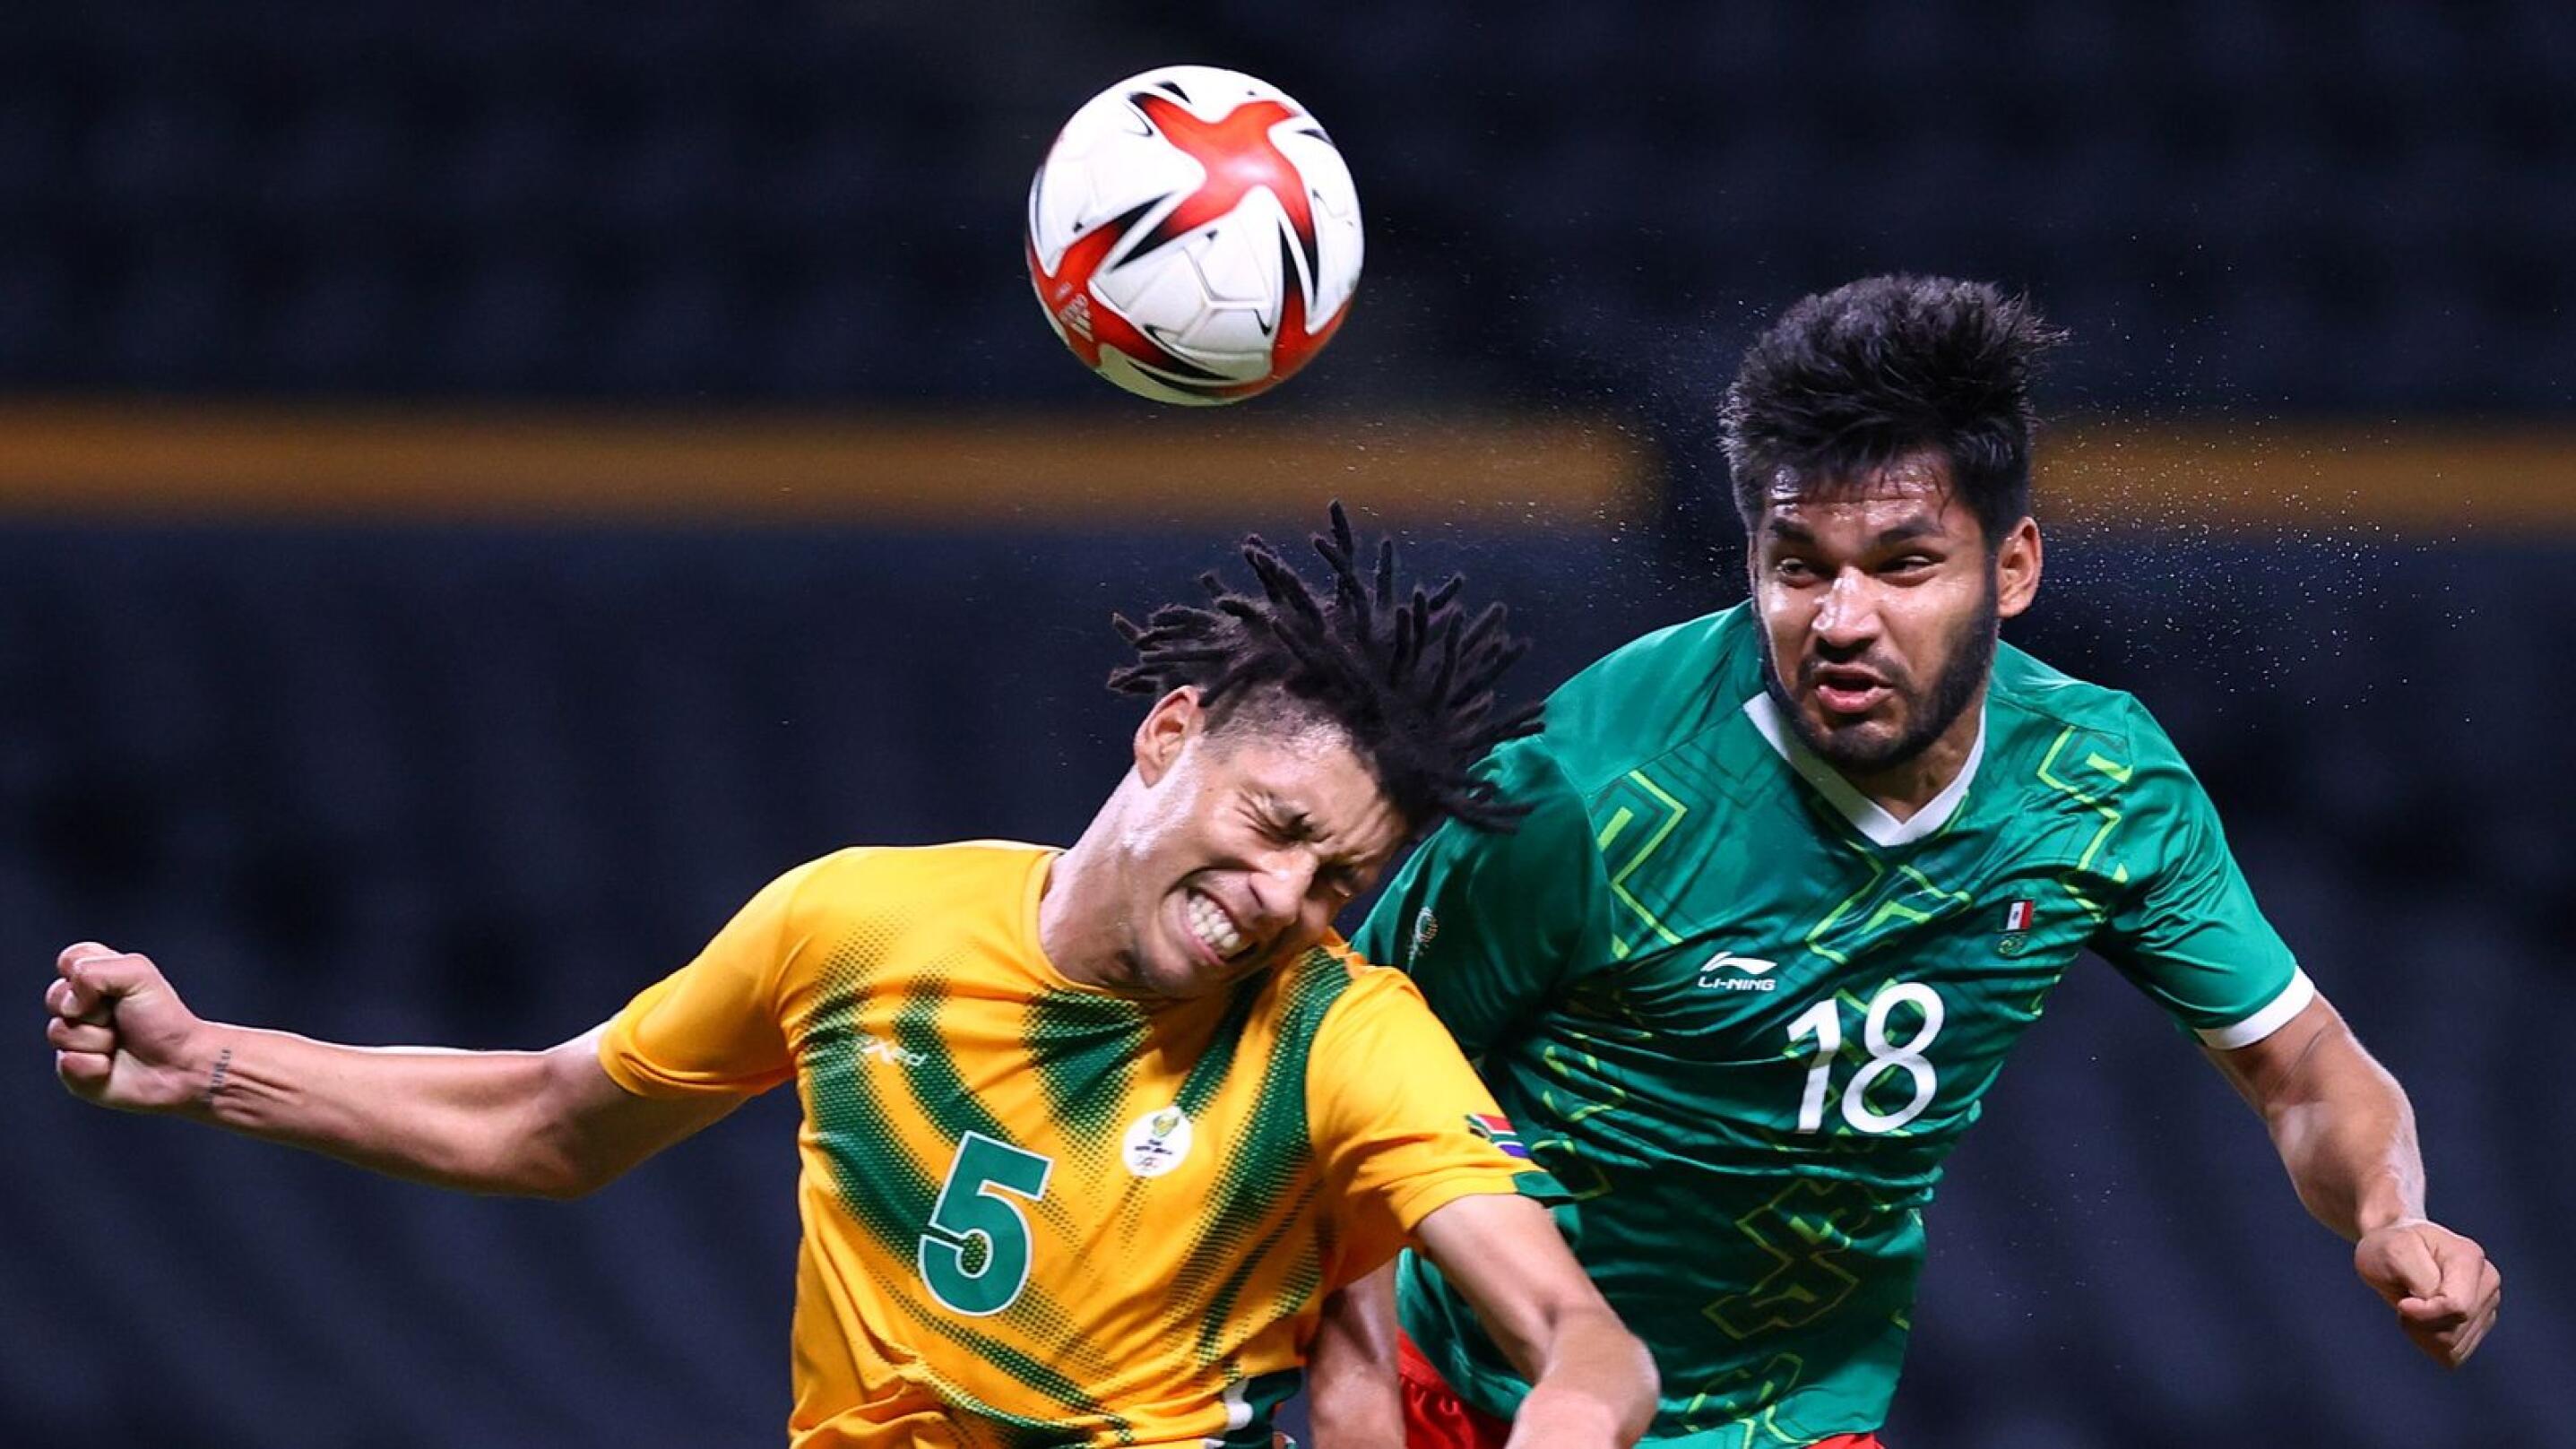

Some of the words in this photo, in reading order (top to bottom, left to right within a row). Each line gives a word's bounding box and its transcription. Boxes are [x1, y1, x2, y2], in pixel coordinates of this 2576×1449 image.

[1698, 976, 1776, 991] LI-NING
[1786, 982, 1944, 1133] 18
[918, 1130, 1055, 1316] 5
